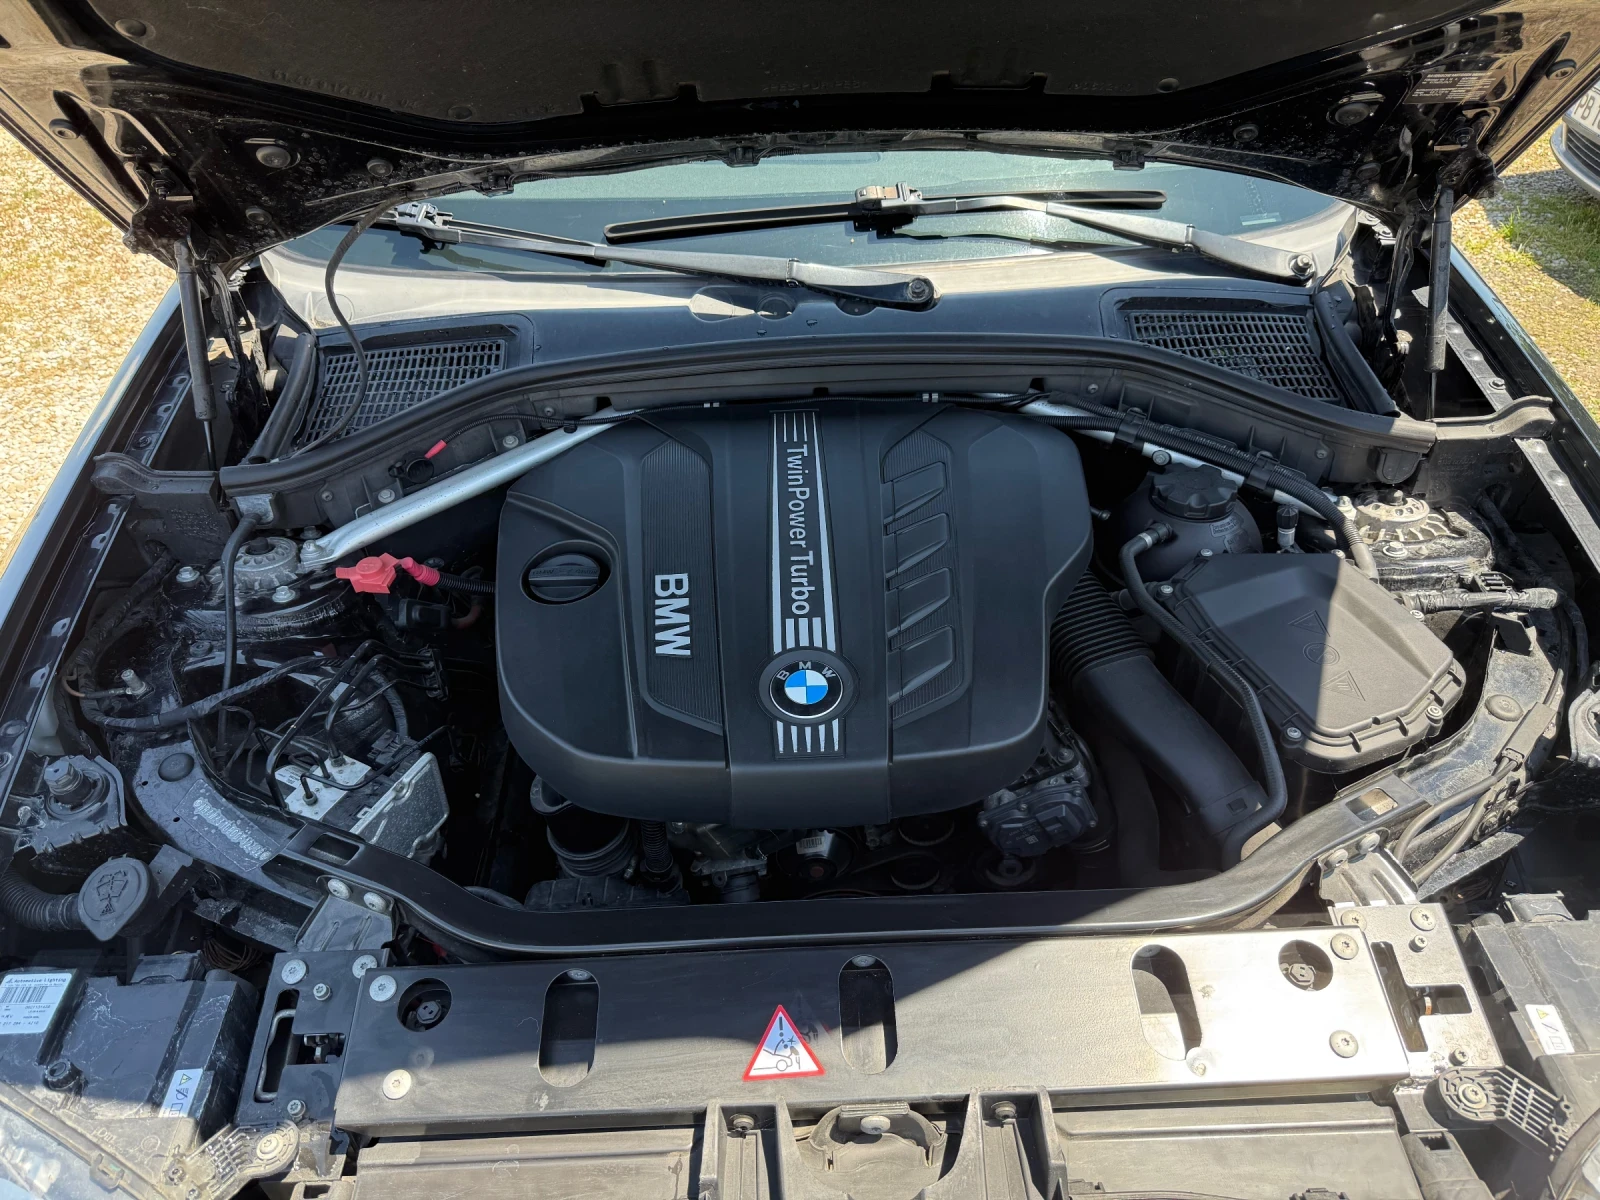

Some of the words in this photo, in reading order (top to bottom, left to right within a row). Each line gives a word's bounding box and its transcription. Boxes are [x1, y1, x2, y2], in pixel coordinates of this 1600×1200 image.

[1574, 93, 1596, 121] PB
[786, 444, 811, 549] TwinPower
[655, 573, 691, 656] BMW
[789, 550, 815, 615] Turbo
[776, 661, 836, 681] BMW
